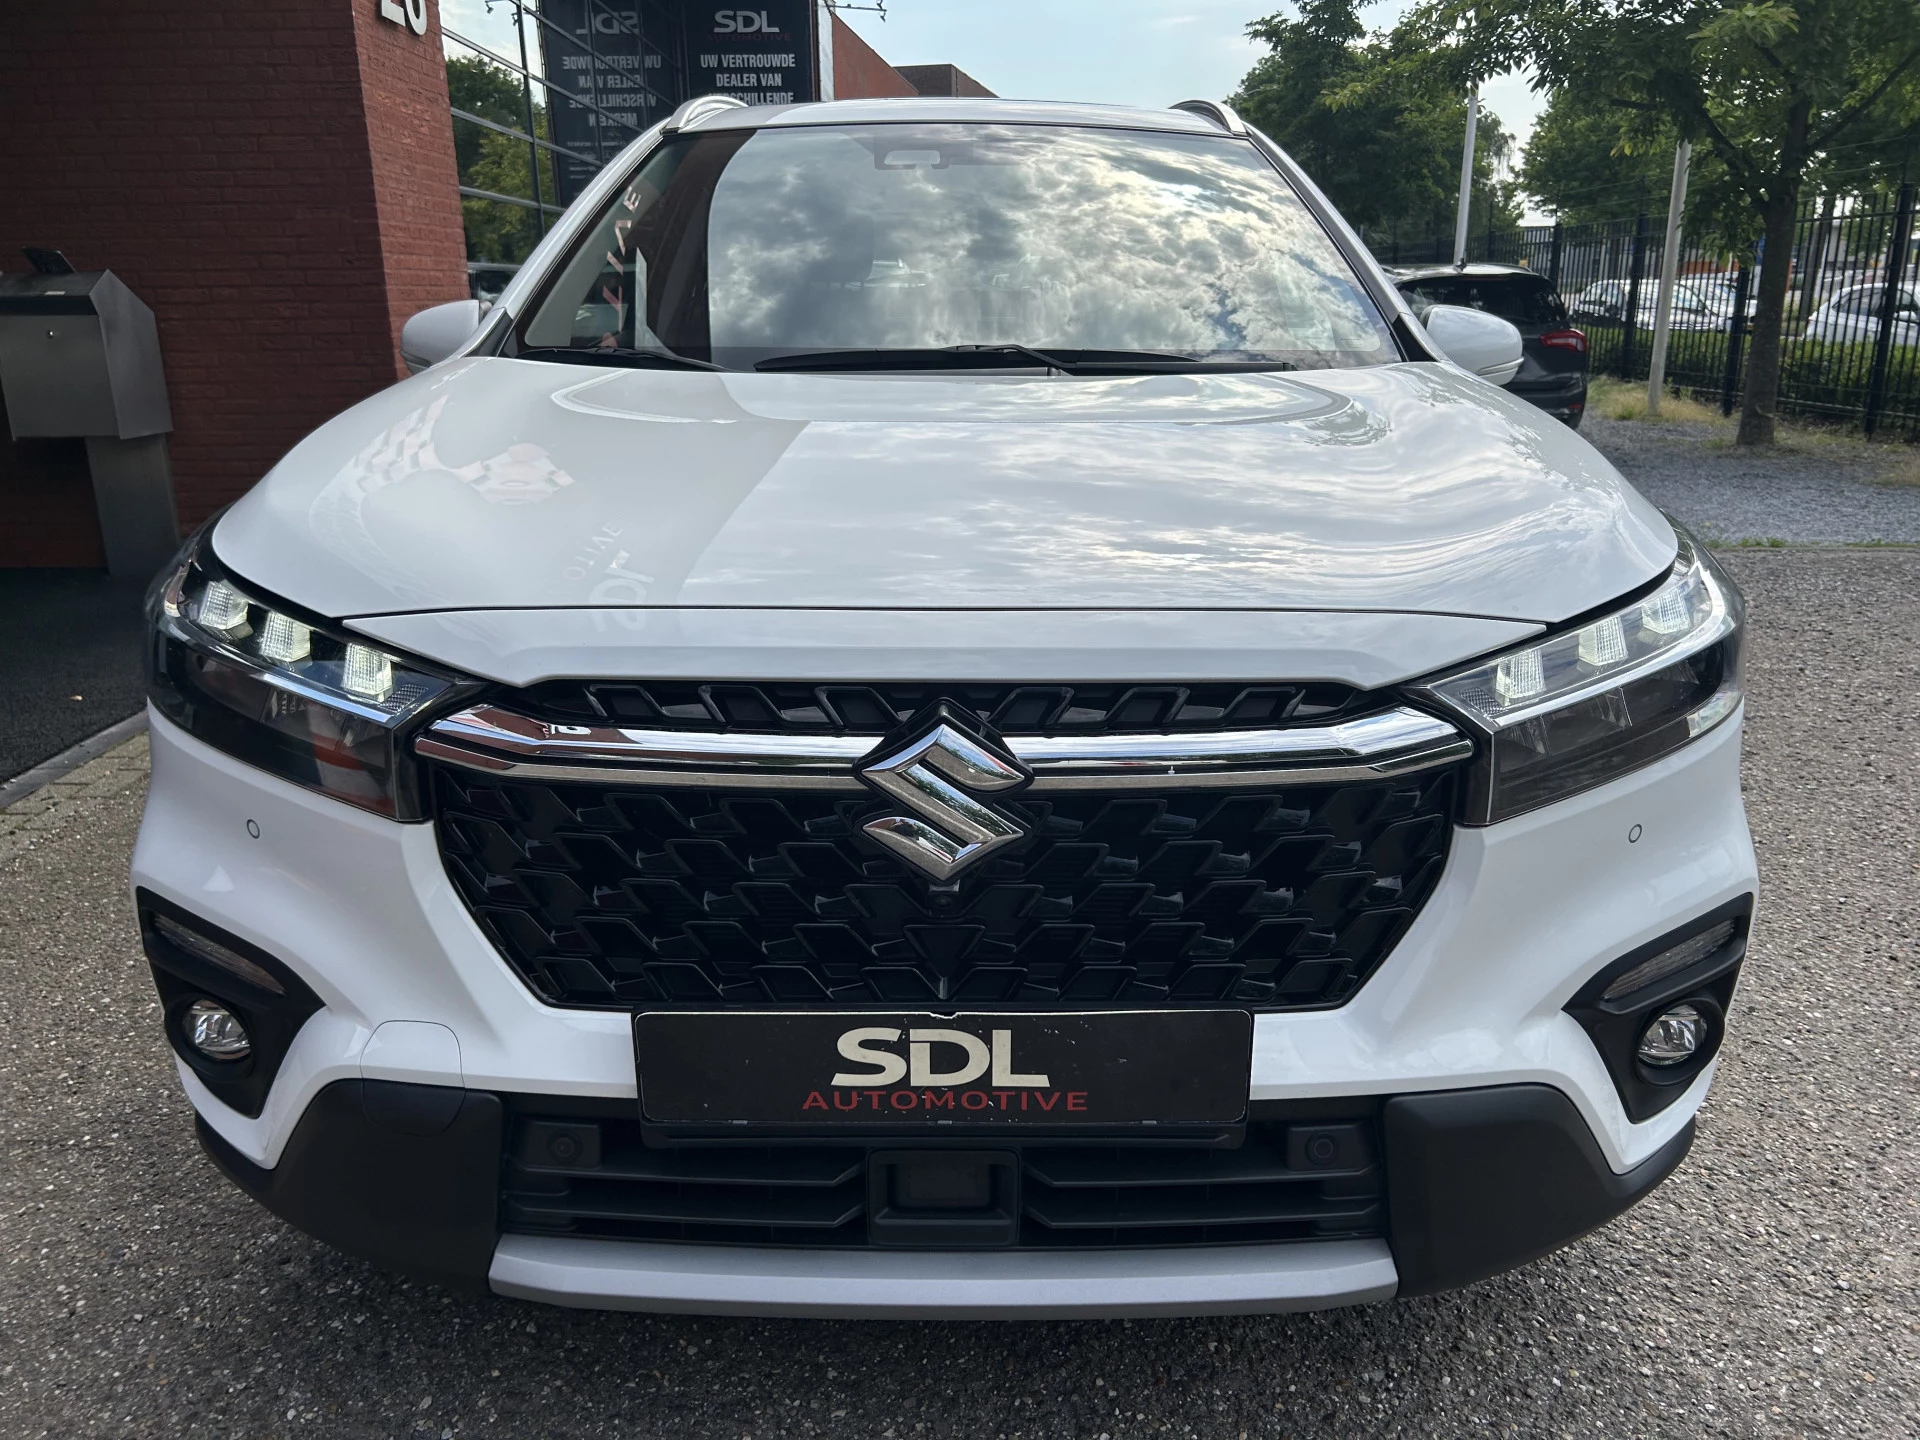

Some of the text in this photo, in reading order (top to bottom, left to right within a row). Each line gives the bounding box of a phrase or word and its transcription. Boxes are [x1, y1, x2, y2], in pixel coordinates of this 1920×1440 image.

[713, 10, 780, 33] SDL
[700, 54, 796, 68] UW VERTROUWDE
[716, 73, 782, 87] DEALER VAN
[708, 92, 794, 106] CHILLENDE
[830, 1027, 1051, 1087] SDL
[801, 1090, 1089, 1111] AUTOMOTIVE
